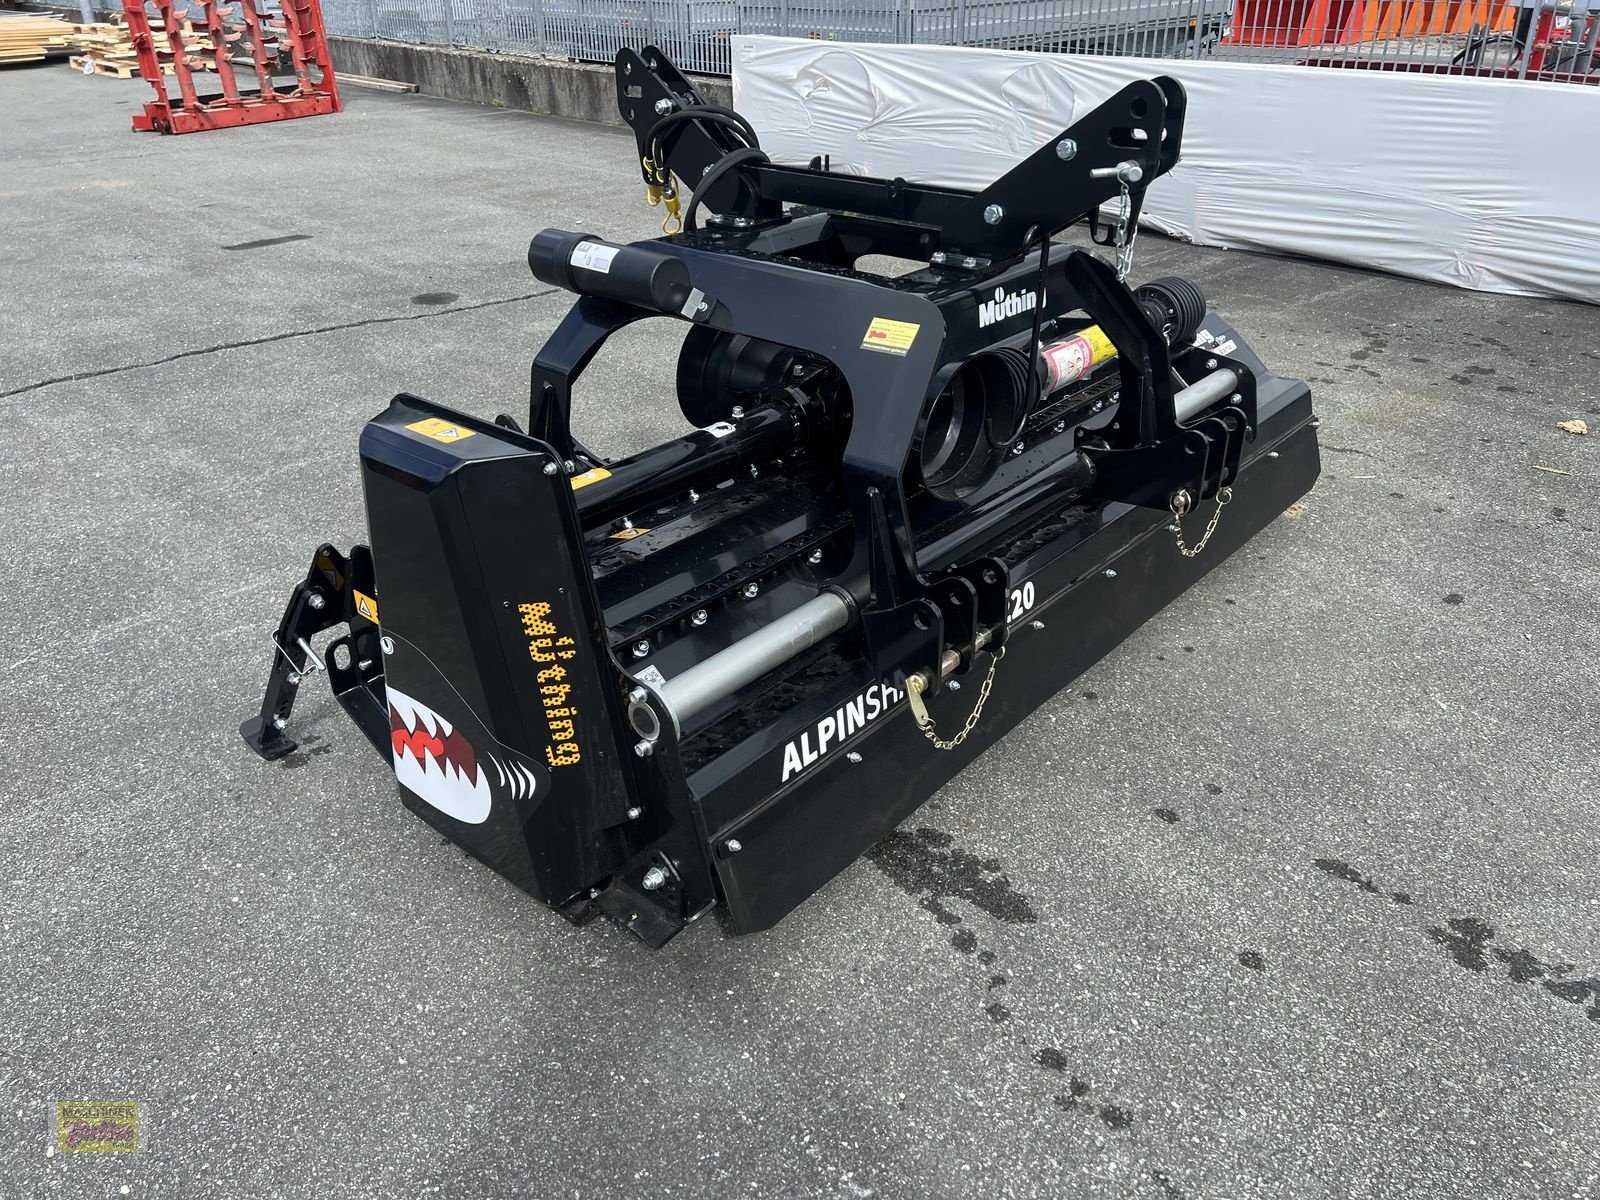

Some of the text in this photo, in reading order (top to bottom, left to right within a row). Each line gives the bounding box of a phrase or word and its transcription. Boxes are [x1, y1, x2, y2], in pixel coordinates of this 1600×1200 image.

[979, 287, 1047, 328] Müthin
[518, 602, 581, 766] Müthing
[781, 683, 905, 783] ALPINSH
